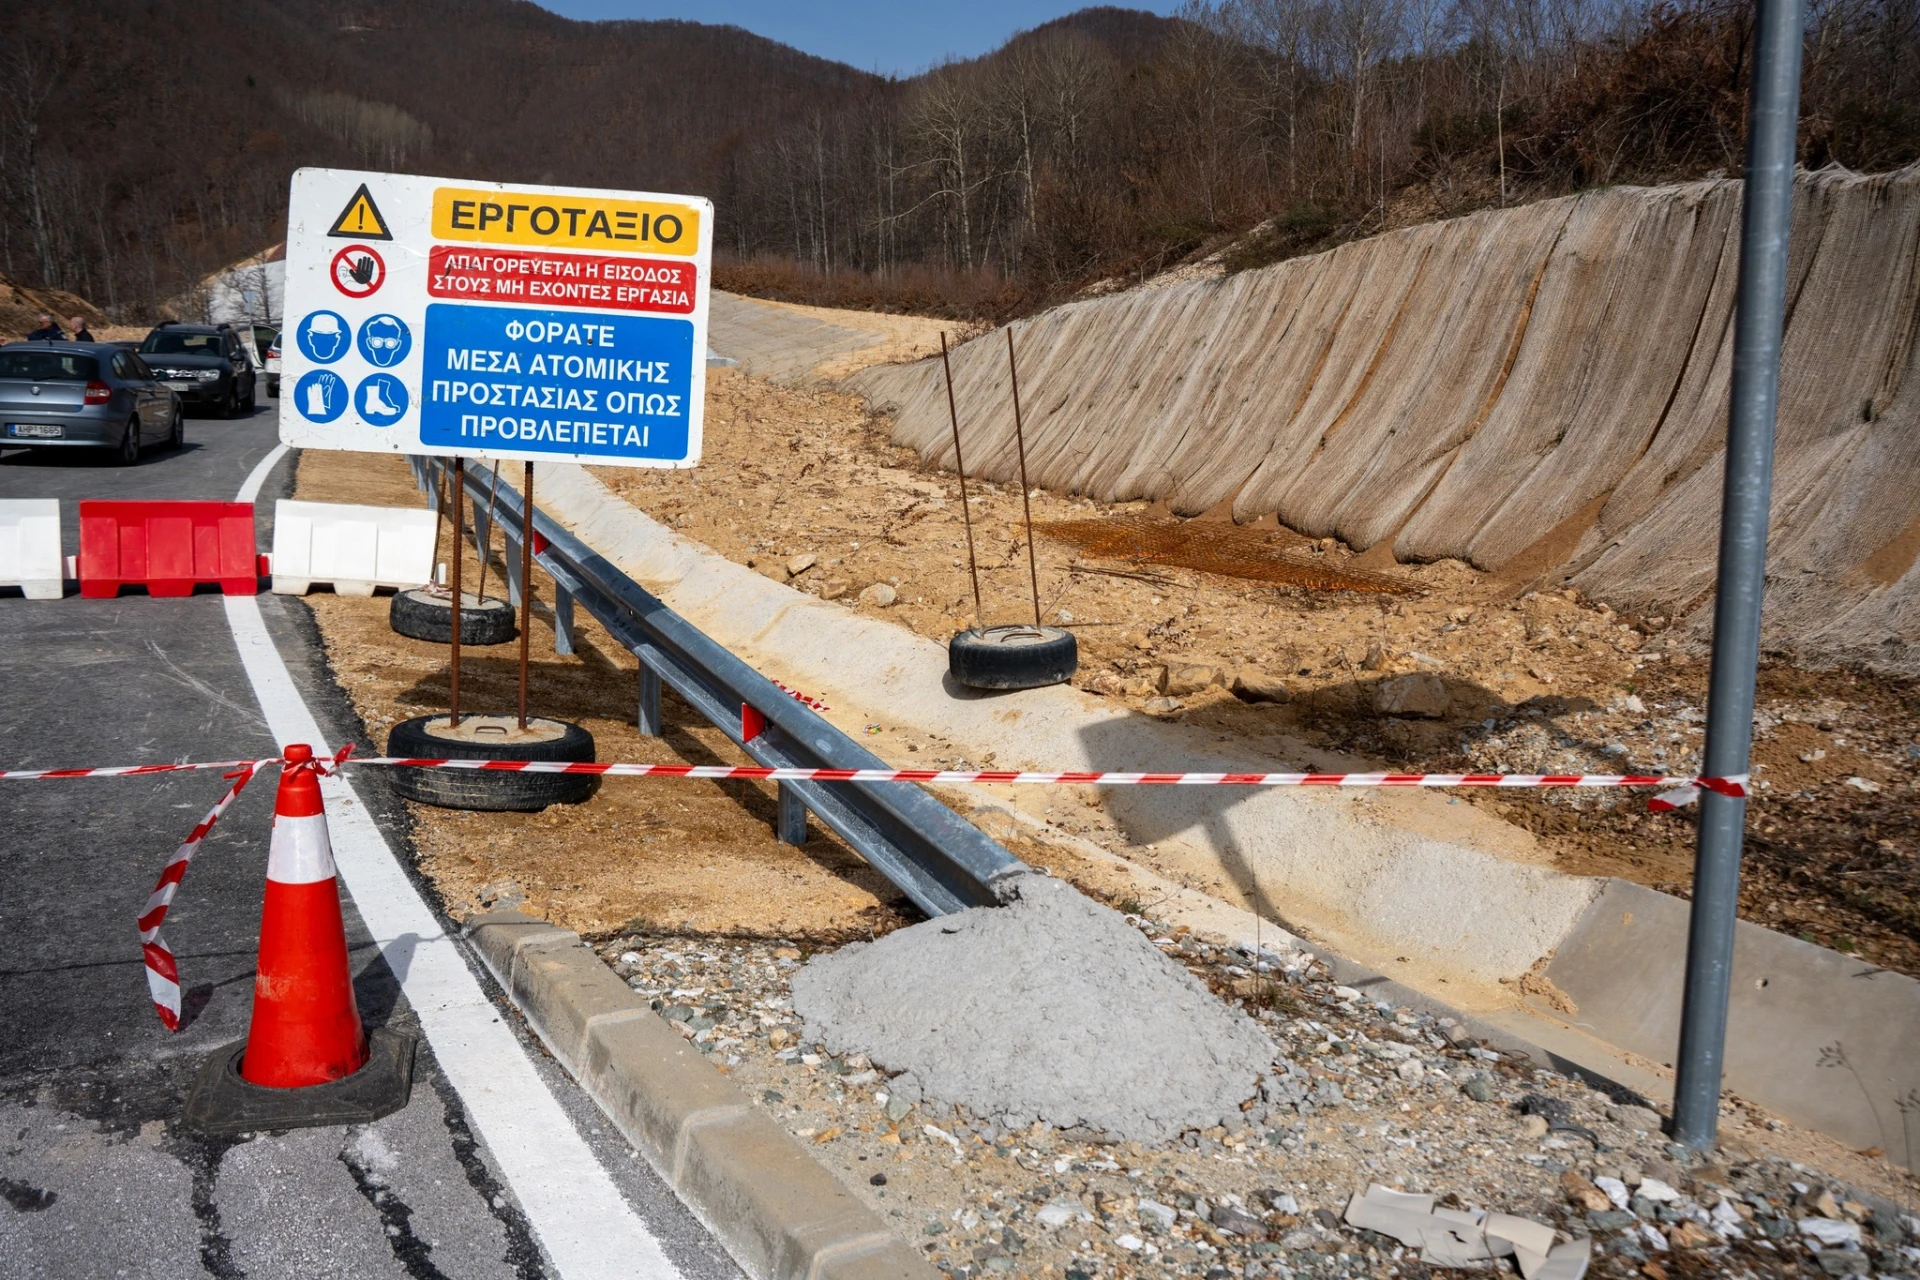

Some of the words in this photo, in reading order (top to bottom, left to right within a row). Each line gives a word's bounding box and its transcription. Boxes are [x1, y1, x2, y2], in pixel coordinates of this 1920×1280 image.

[452, 201, 682, 243] ΕΡΓΟΤΑΞΙΟ
[444, 254, 581, 277] ΑΠΑΓΟΡΕΥΕΤΑΙ
[586, 264, 598, 277] Η
[604, 265, 681, 284] ΕΙΣΟΔΟΣ
[433, 275, 490, 293] ΣΤΟΥΣ
[497, 279, 523, 295] ΜΗ
[530, 282, 611, 301] ΕΧΟΝΤΕΣ
[617, 287, 689, 306] ΕΡΓΑΣΙΑ
[505, 320, 614, 347] ΦΟΡΑΤΕ
[447, 349, 521, 374] ΜΕΣΑ
[529, 354, 670, 383] ΑΤΟΜΙΚΗΣ
[432, 381, 598, 412] ΠΡΟΣΤΑΣΙΑΣ
[607, 392, 681, 416] ΟΠΩΣ
[461, 415, 648, 446] ΠΡΟΒΛΕΠΕΤΑΙ
